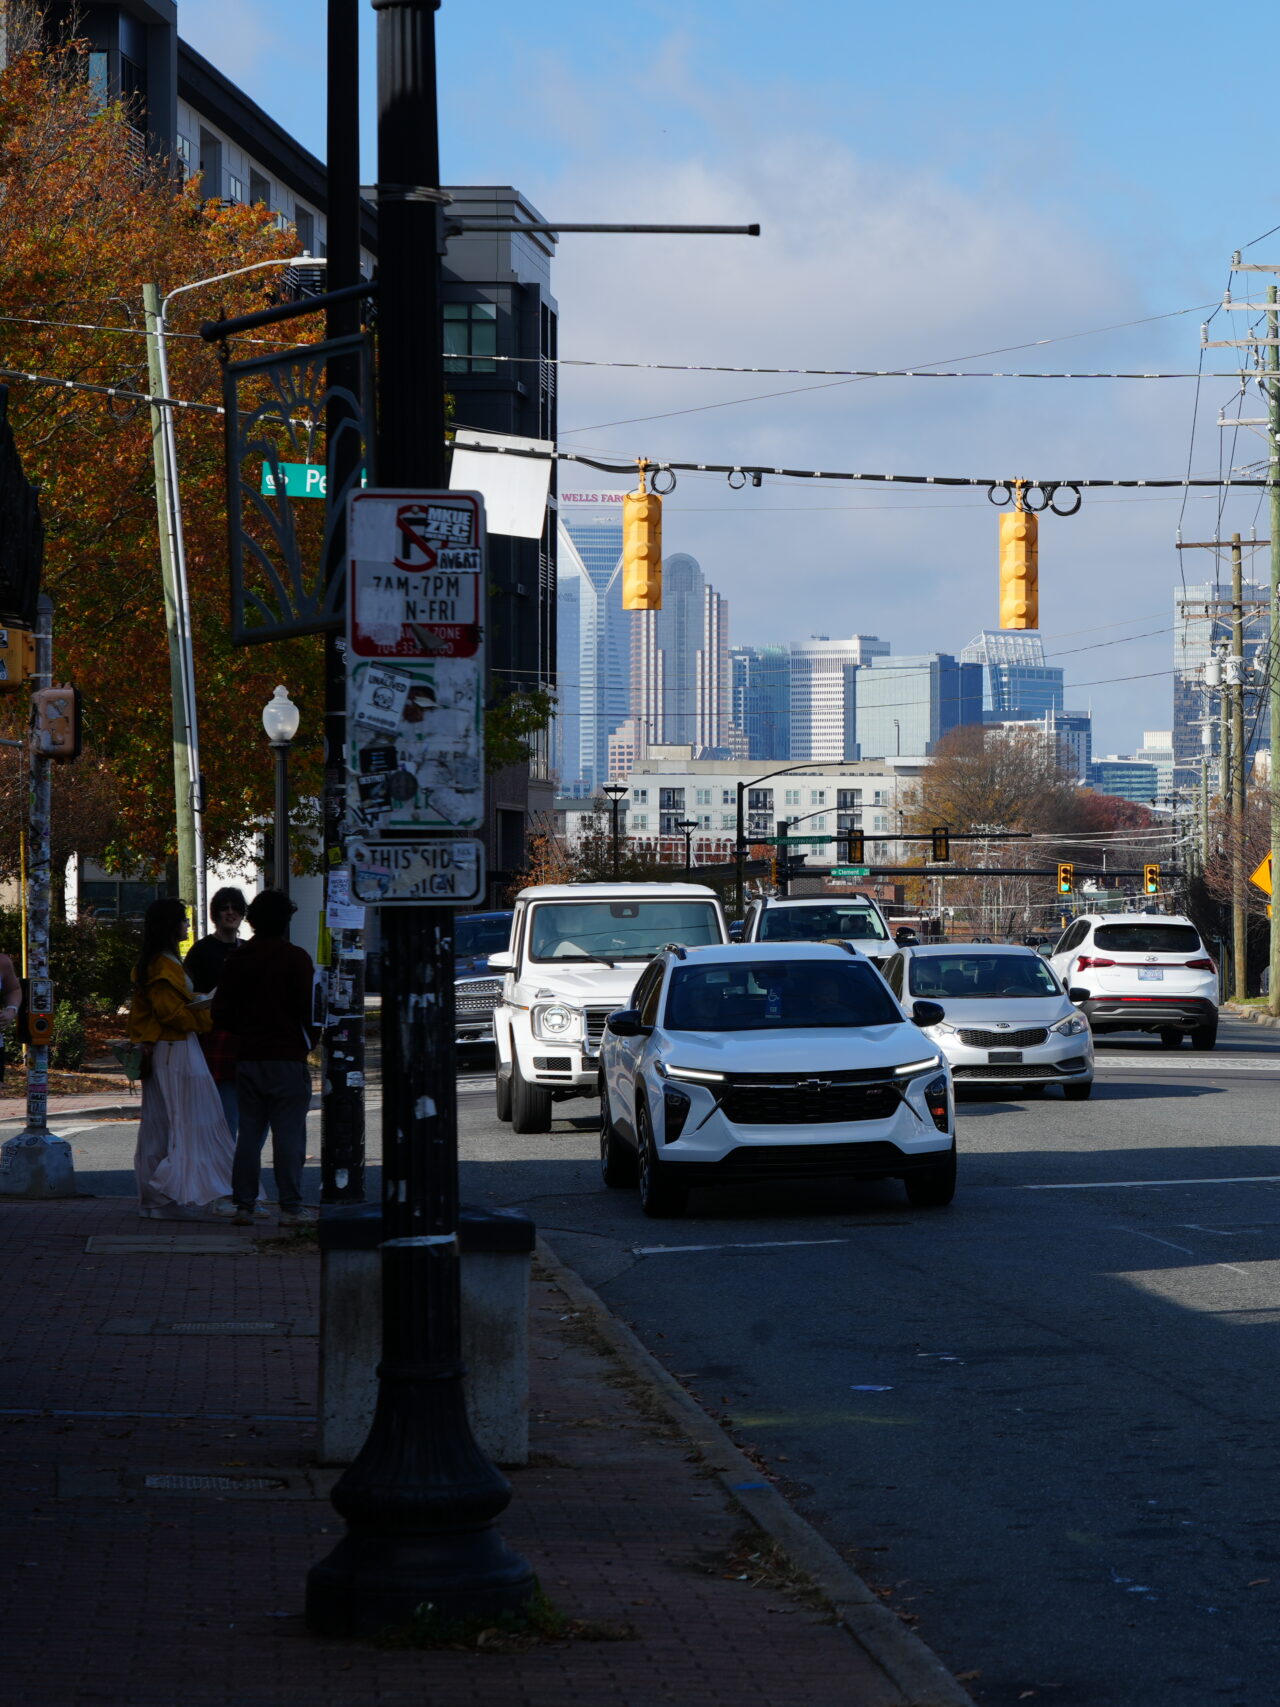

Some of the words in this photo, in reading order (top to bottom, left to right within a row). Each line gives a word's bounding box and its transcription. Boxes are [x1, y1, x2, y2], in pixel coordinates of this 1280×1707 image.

[561, 493, 599, 503] WELLS
[600, 494, 624, 503] FAR
[440, 551, 477, 569] AVERT
[405, 600, 456, 621] N-FRI
[774, 836, 820, 845] Commonwealth
[370, 849, 411, 869] THIS
[421, 848, 453, 869] SID
